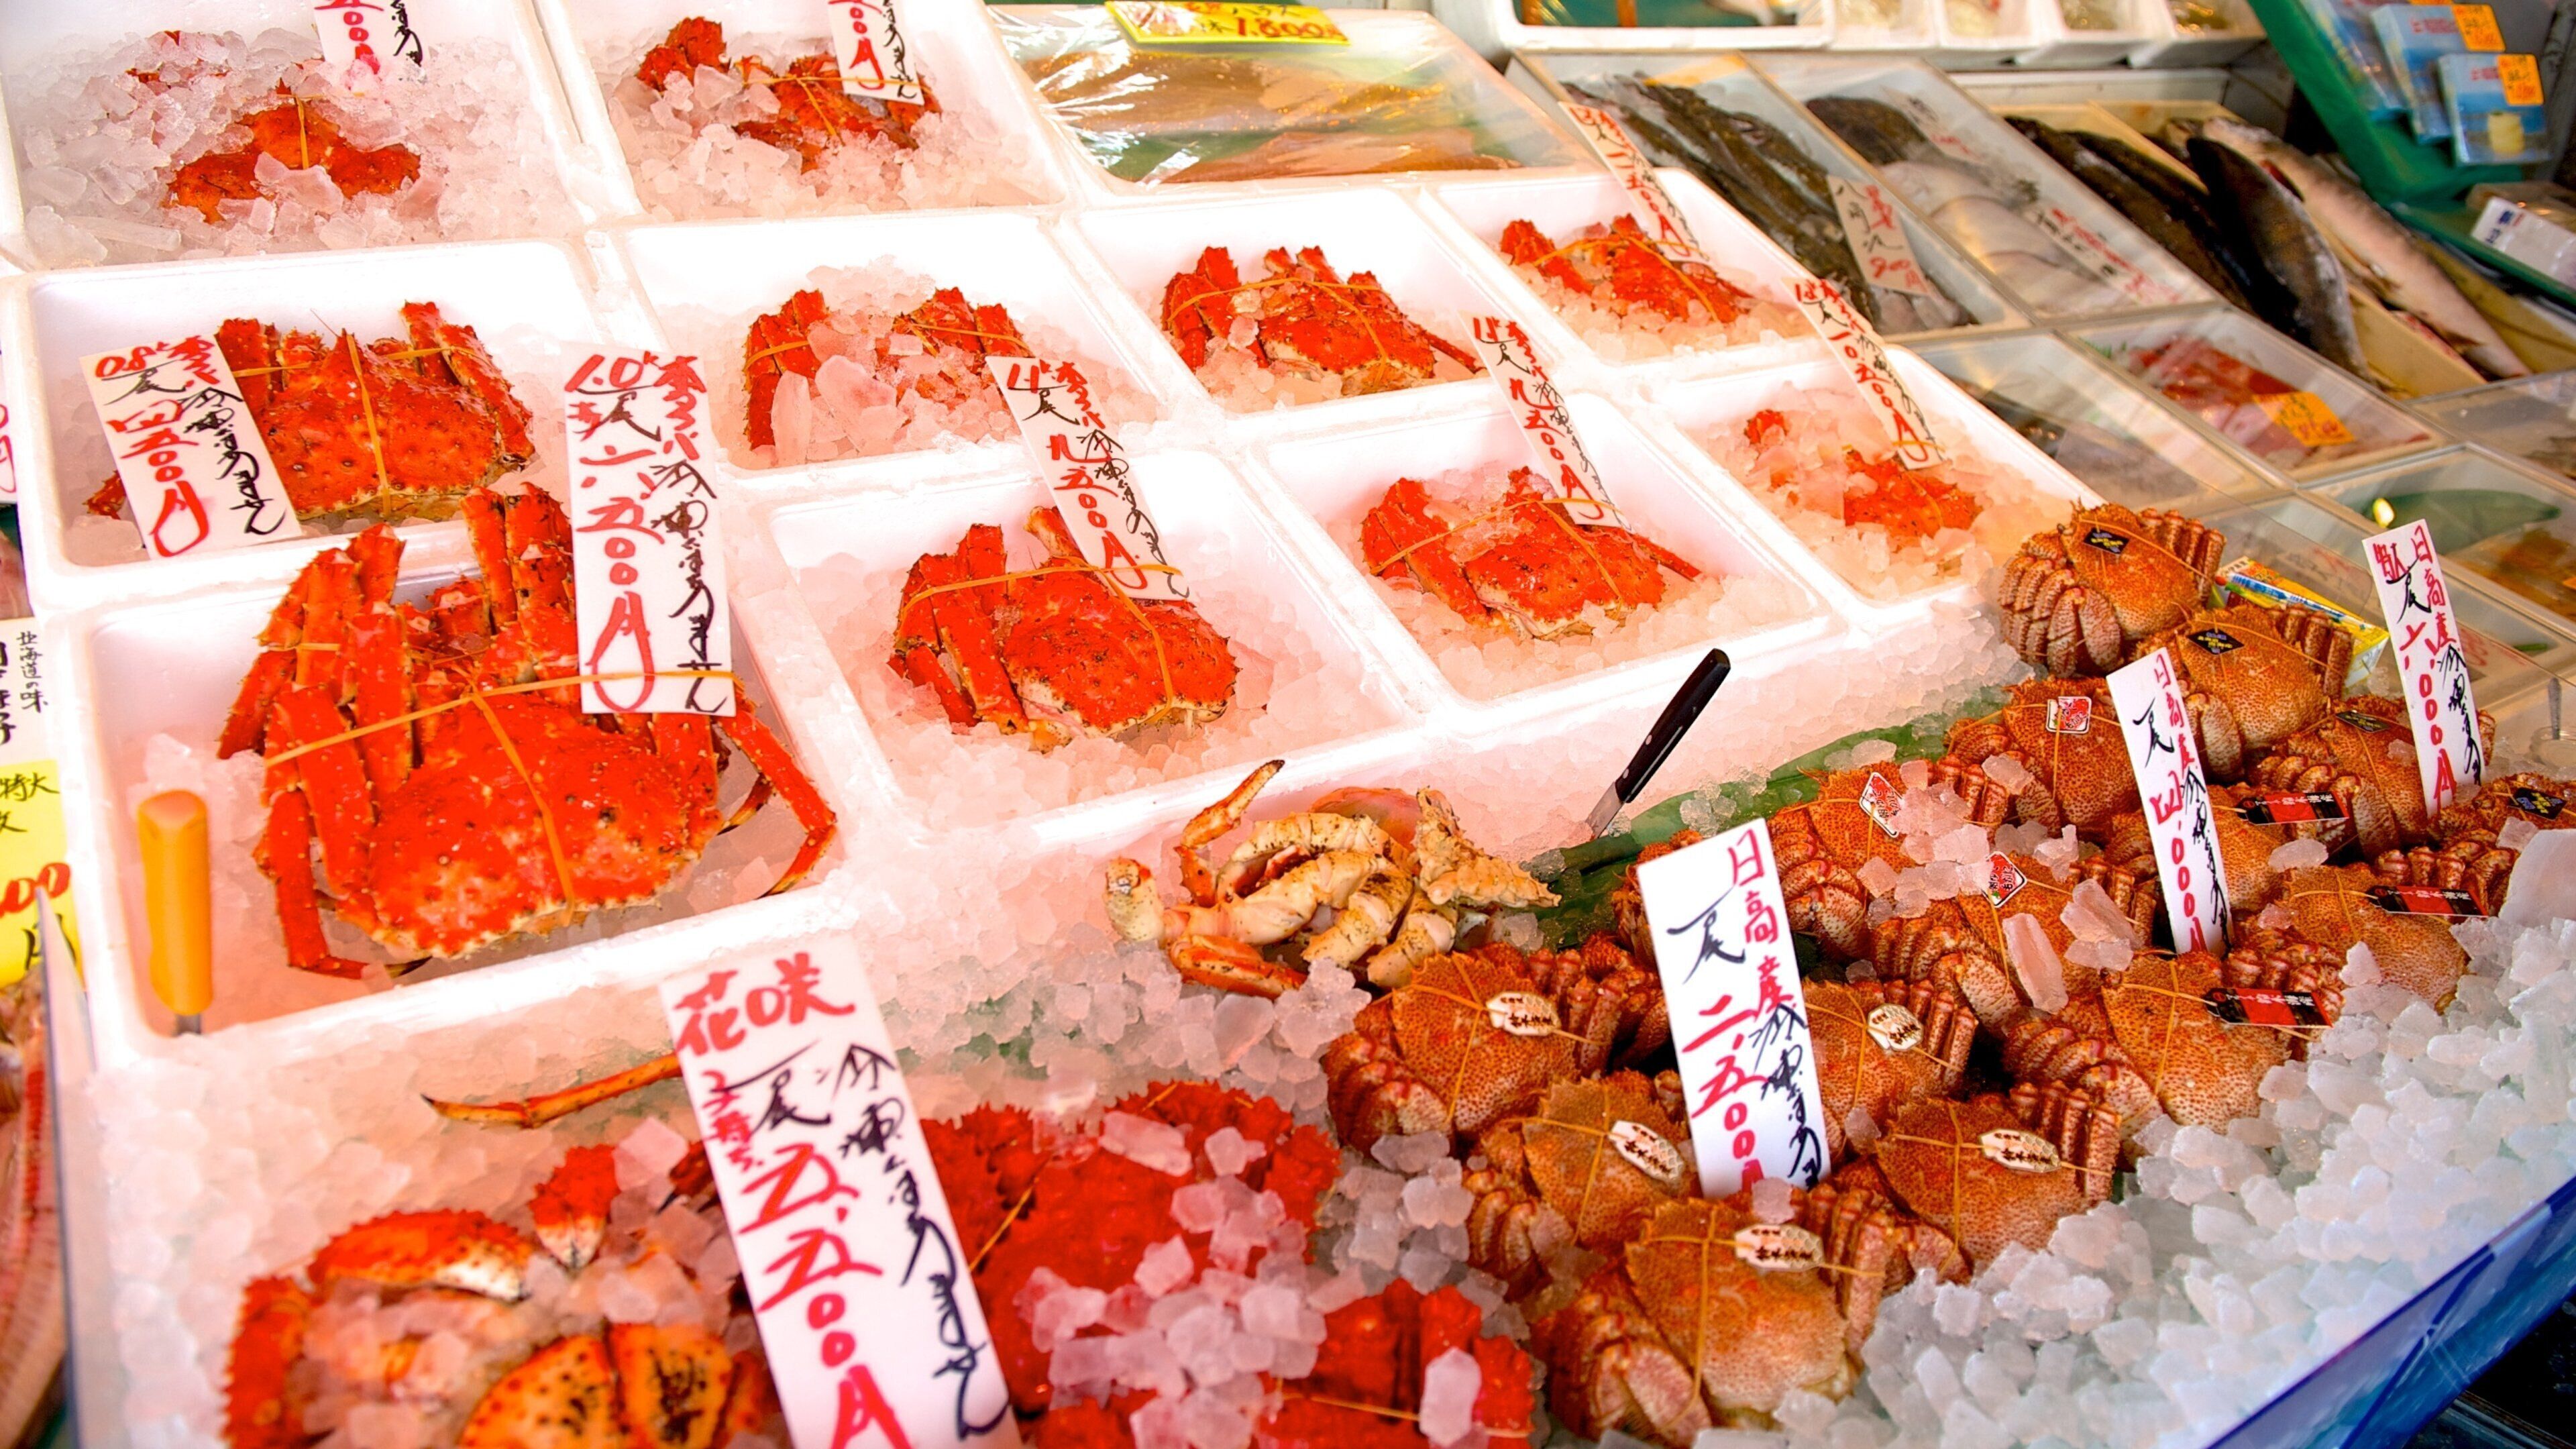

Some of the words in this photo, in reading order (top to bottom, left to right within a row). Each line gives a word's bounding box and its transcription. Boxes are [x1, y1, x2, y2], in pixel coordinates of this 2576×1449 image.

[16, 630, 49, 713] 北海道の味
[674, 952, 856, 1057] 花咲
